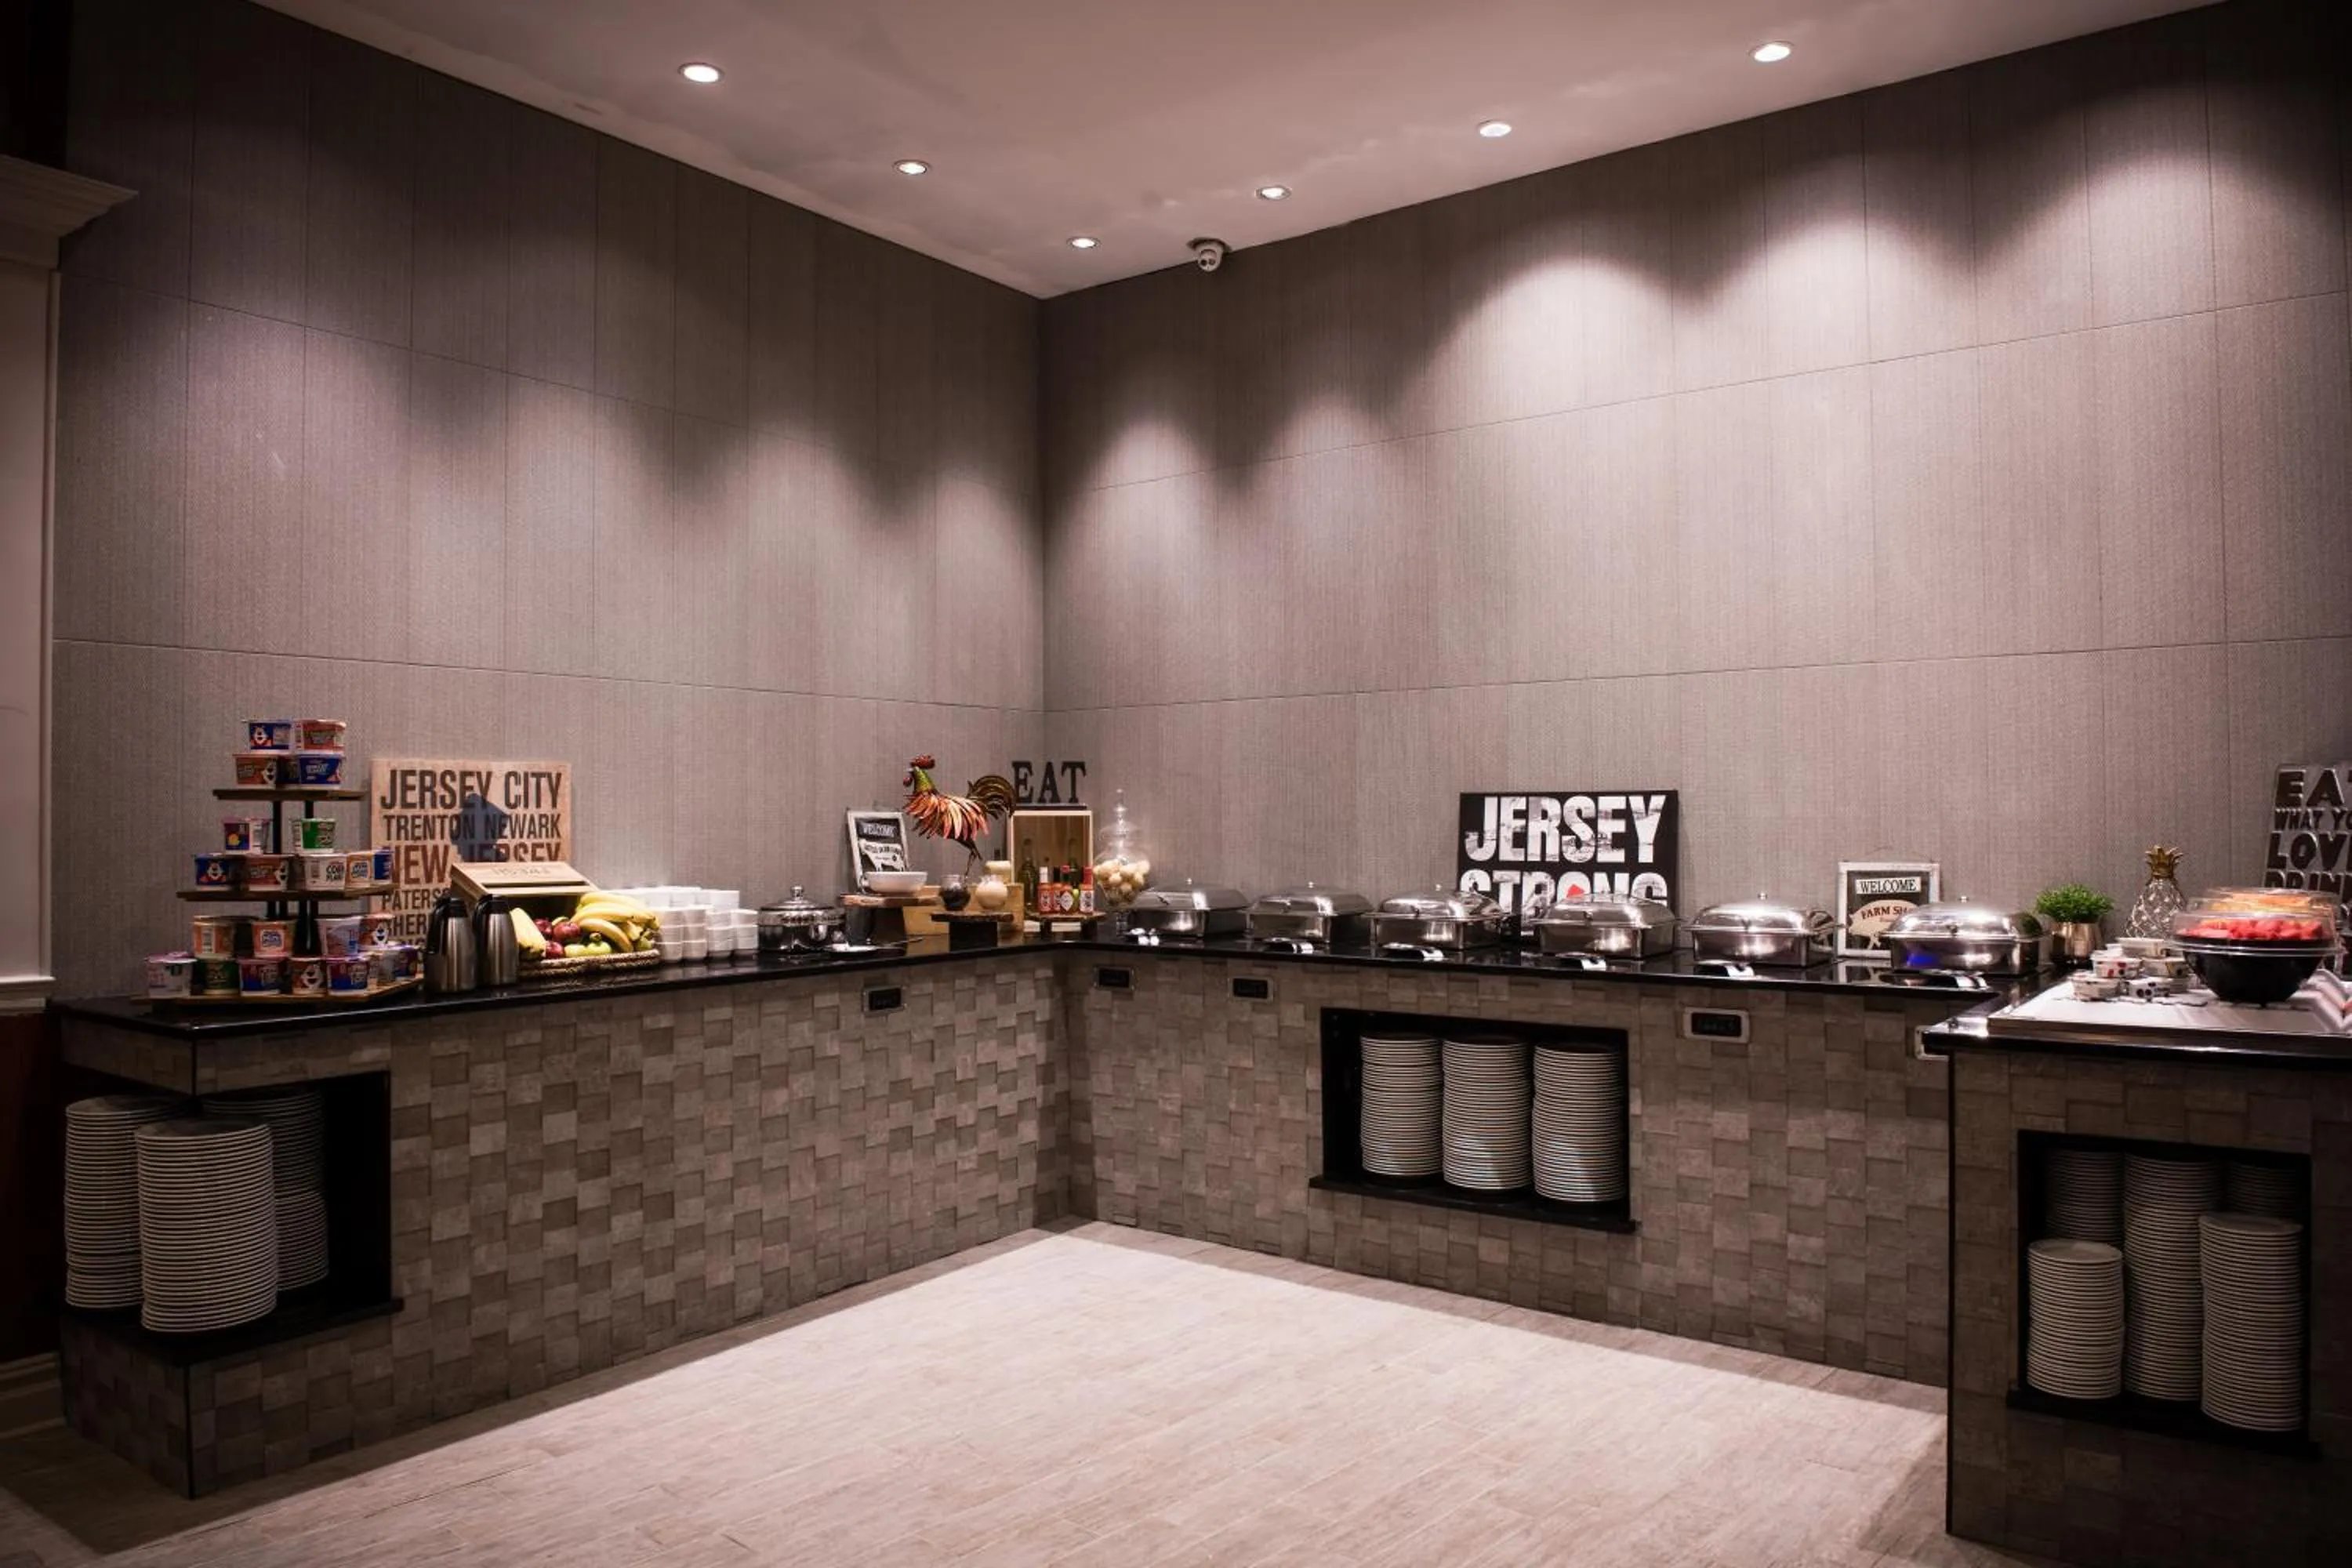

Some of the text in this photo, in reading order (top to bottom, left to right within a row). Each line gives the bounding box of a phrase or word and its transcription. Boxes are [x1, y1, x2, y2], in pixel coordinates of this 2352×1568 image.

[380, 769, 562, 810] JERSEY CITY
[1011, 761, 1087, 804] EAT
[2275, 768, 2352, 807] EA
[383, 814, 562, 841] TRENTON NEWARK
[1465, 795, 1666, 862] JERSEY
[2274, 808, 2325, 830] WHAT
[2267, 831, 2352, 869] LOV
[382, 887, 451, 911] PATERS
[1860, 879, 1917, 893] WELCOME
[1860, 906, 1890, 920] FARM
